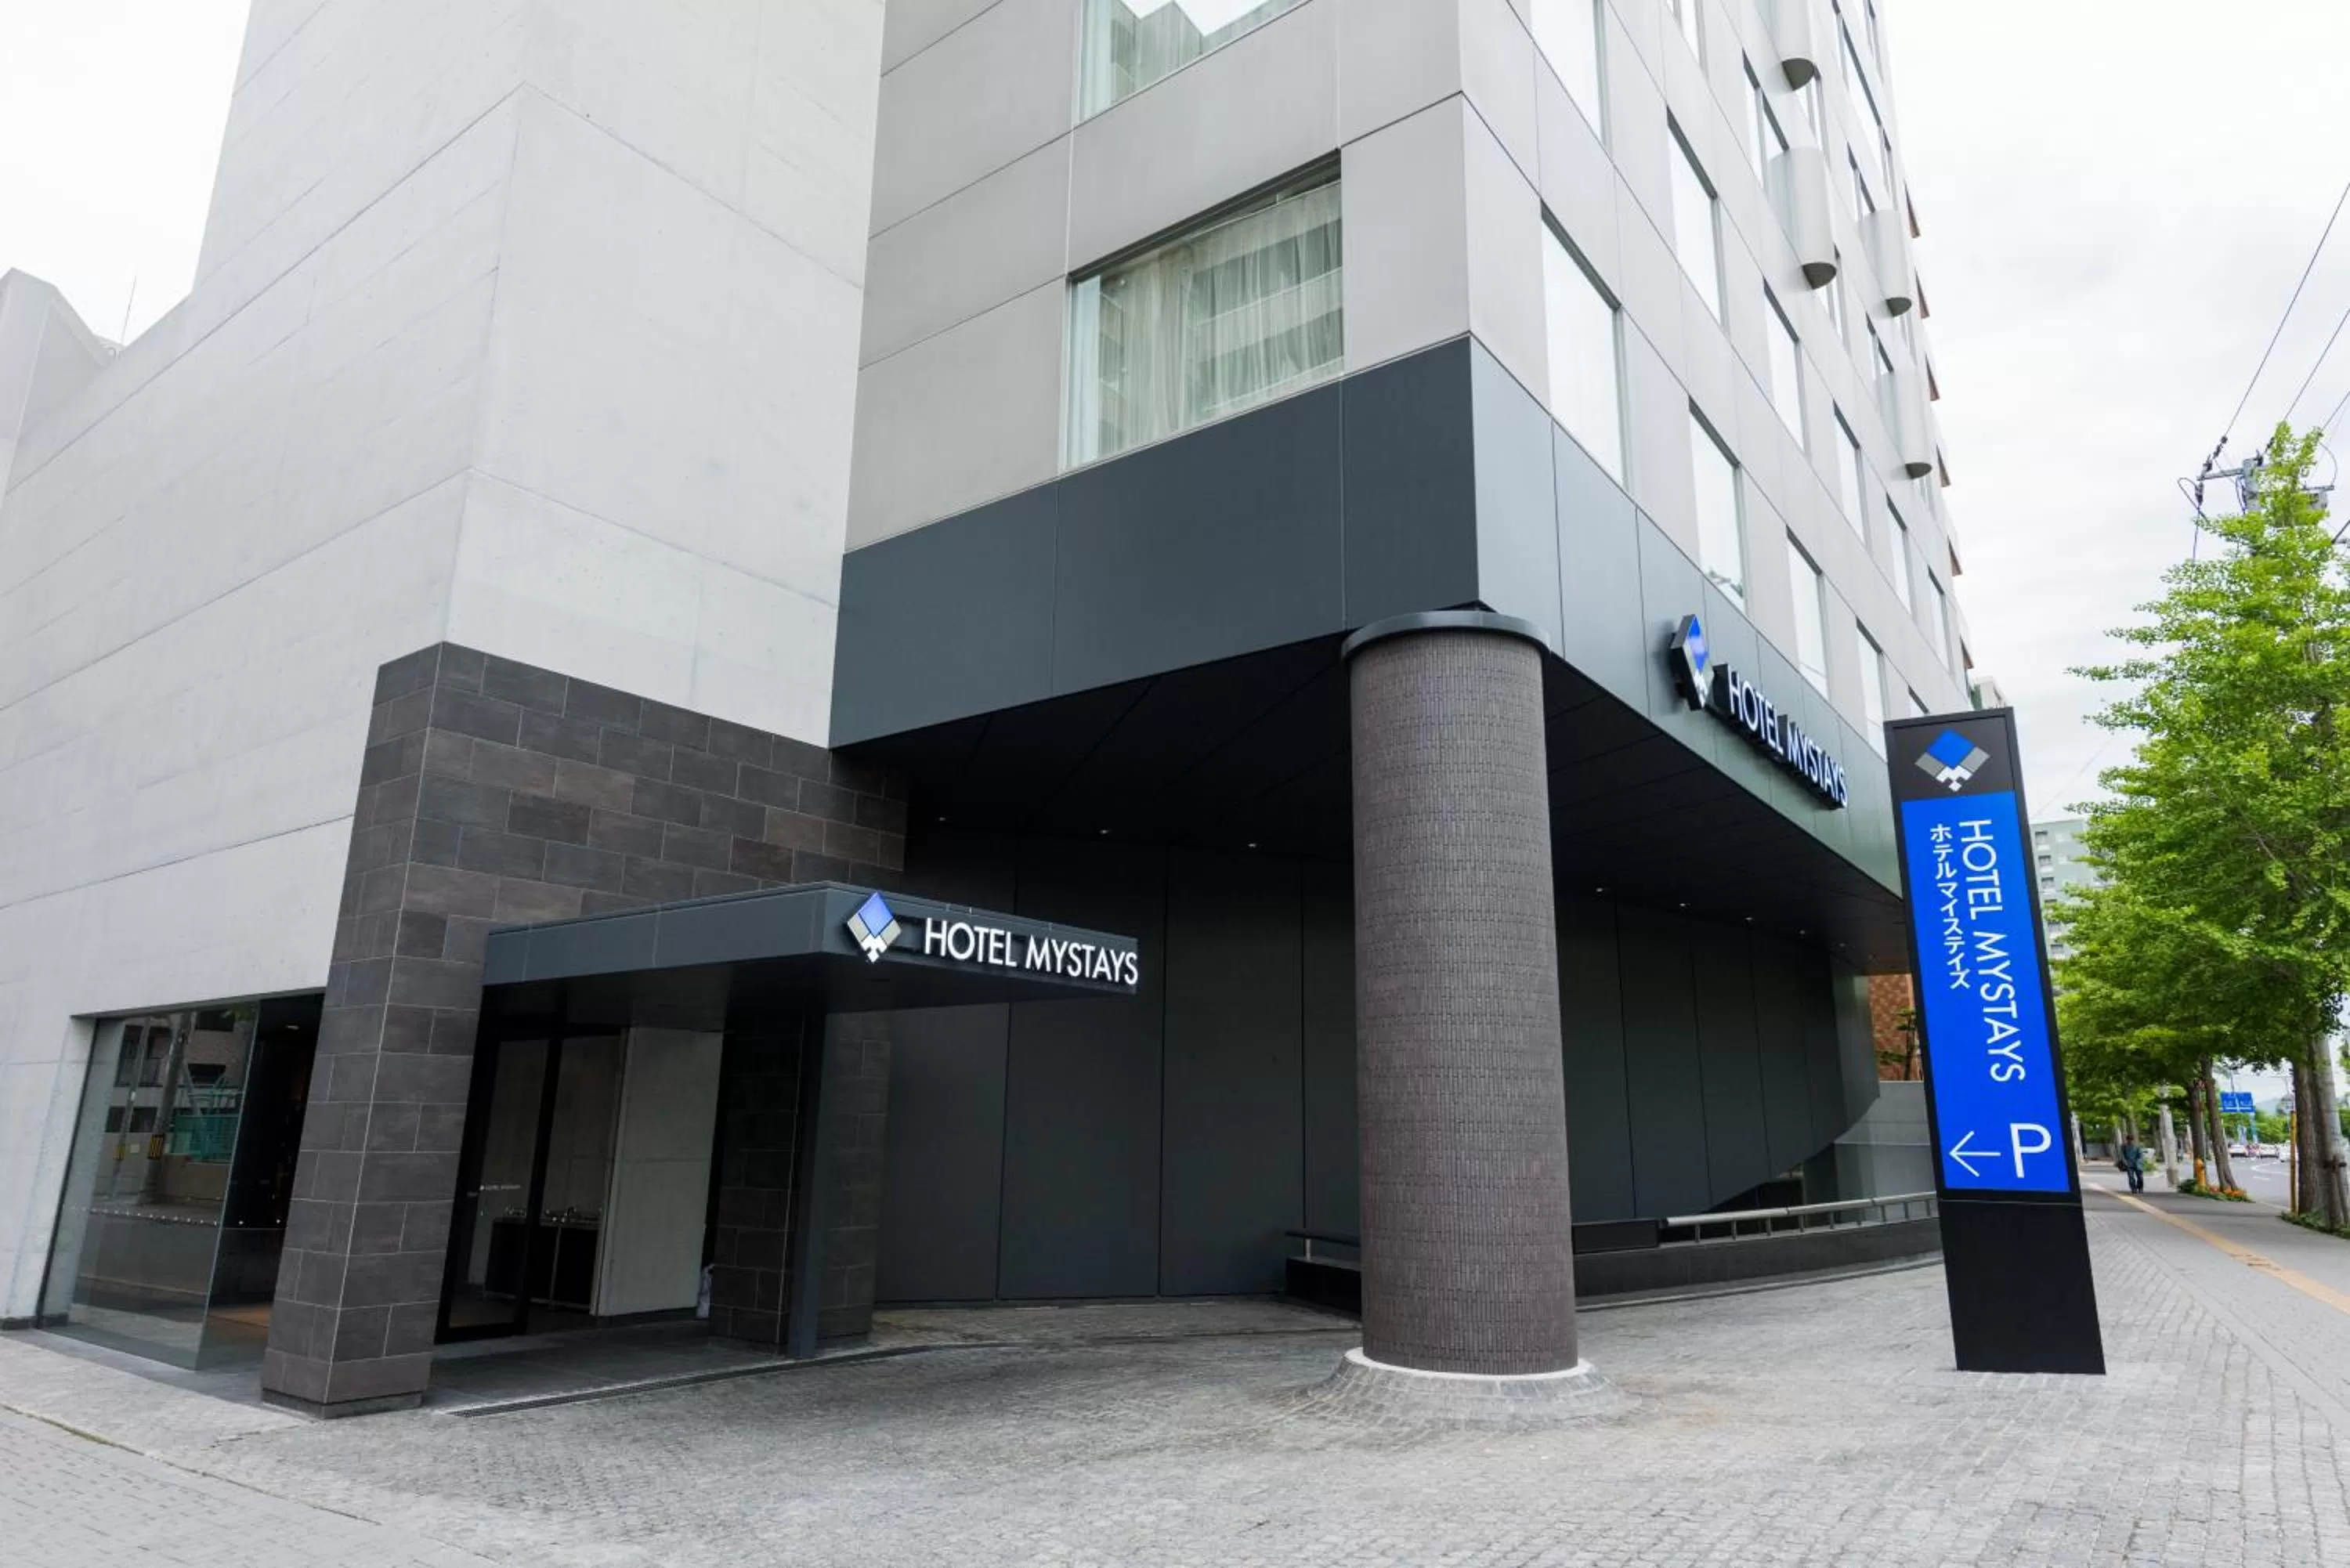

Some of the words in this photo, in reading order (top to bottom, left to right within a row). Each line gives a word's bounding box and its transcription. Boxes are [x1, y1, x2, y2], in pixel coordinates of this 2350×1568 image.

[1726, 664, 1784, 756] HOTEL
[1787, 714, 1848, 808] MYSTAYS
[1929, 823, 1971, 990] ホテルマイステイズ
[1958, 819, 2004, 920] HOTEL
[924, 917, 1018, 968] HOTEL
[1025, 934, 1139, 985] MYSTAYS
[1972, 931, 2026, 1082] MYSTAYS
[2009, 1122, 2052, 1179] P
